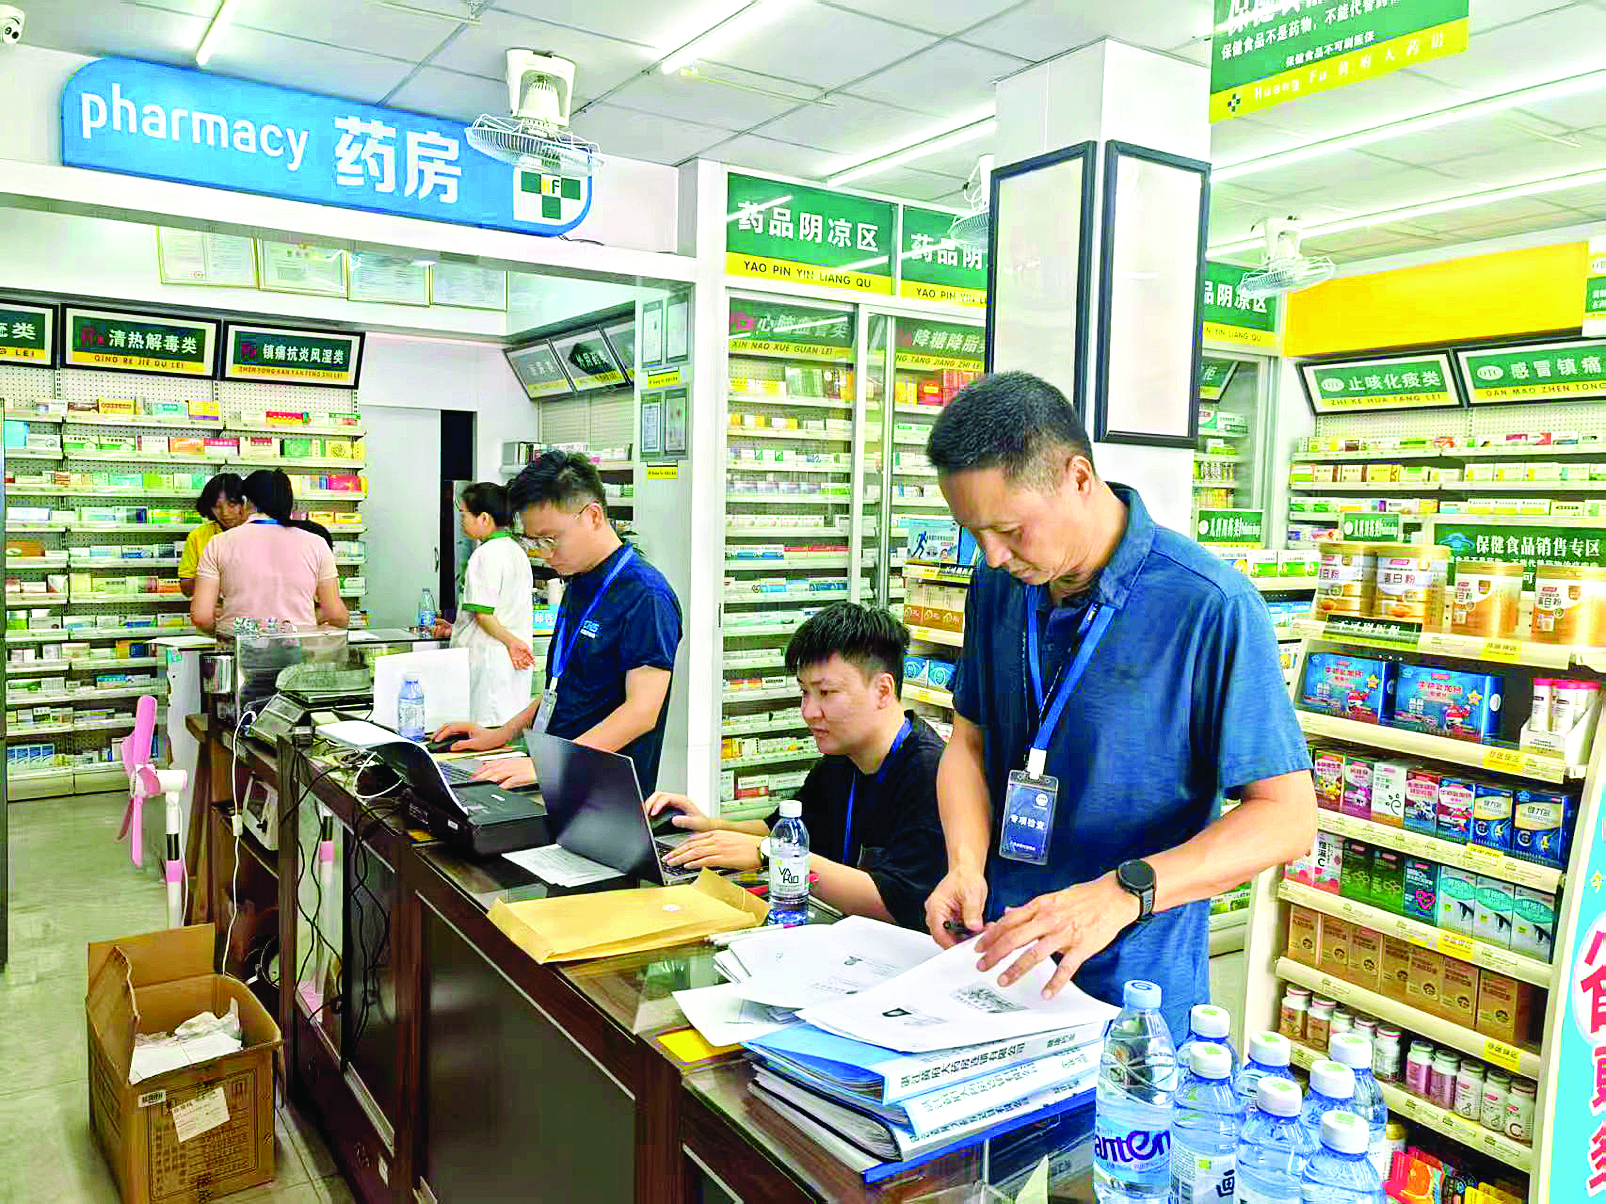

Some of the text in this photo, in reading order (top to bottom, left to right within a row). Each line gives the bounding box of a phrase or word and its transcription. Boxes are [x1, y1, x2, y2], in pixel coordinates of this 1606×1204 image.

[1254, 78, 1300, 100] Huang
[82, 83, 309, 171] pharmacy
[335, 116, 461, 203] 药房
[738, 201, 879, 252] 药品阴凉区
[911, 233, 987, 270] 药品阴
[744, 261, 767, 273] YAO
[773, 265, 791, 276] PIN
[819, 270, 851, 285] LIANG
[856, 277, 872, 288] QU
[916, 288, 936, 298] YAO
[941, 290, 956, 299] PIN
[108, 328, 197, 354] 清热解毒类
[750, 341, 770, 350] NAO
[793, 345, 819, 354] GUAN
[263, 343, 344, 364] 镇痛抗炎风湿类
[910, 355, 932, 365] TANG
[1511, 356, 1602, 379] 感冒镇痛
[1348, 370, 1441, 391] 止咳化痰类
[1542, 385, 1570, 393] ZHEN
[1476, 535, 1600, 557] 保健食品销售专区
